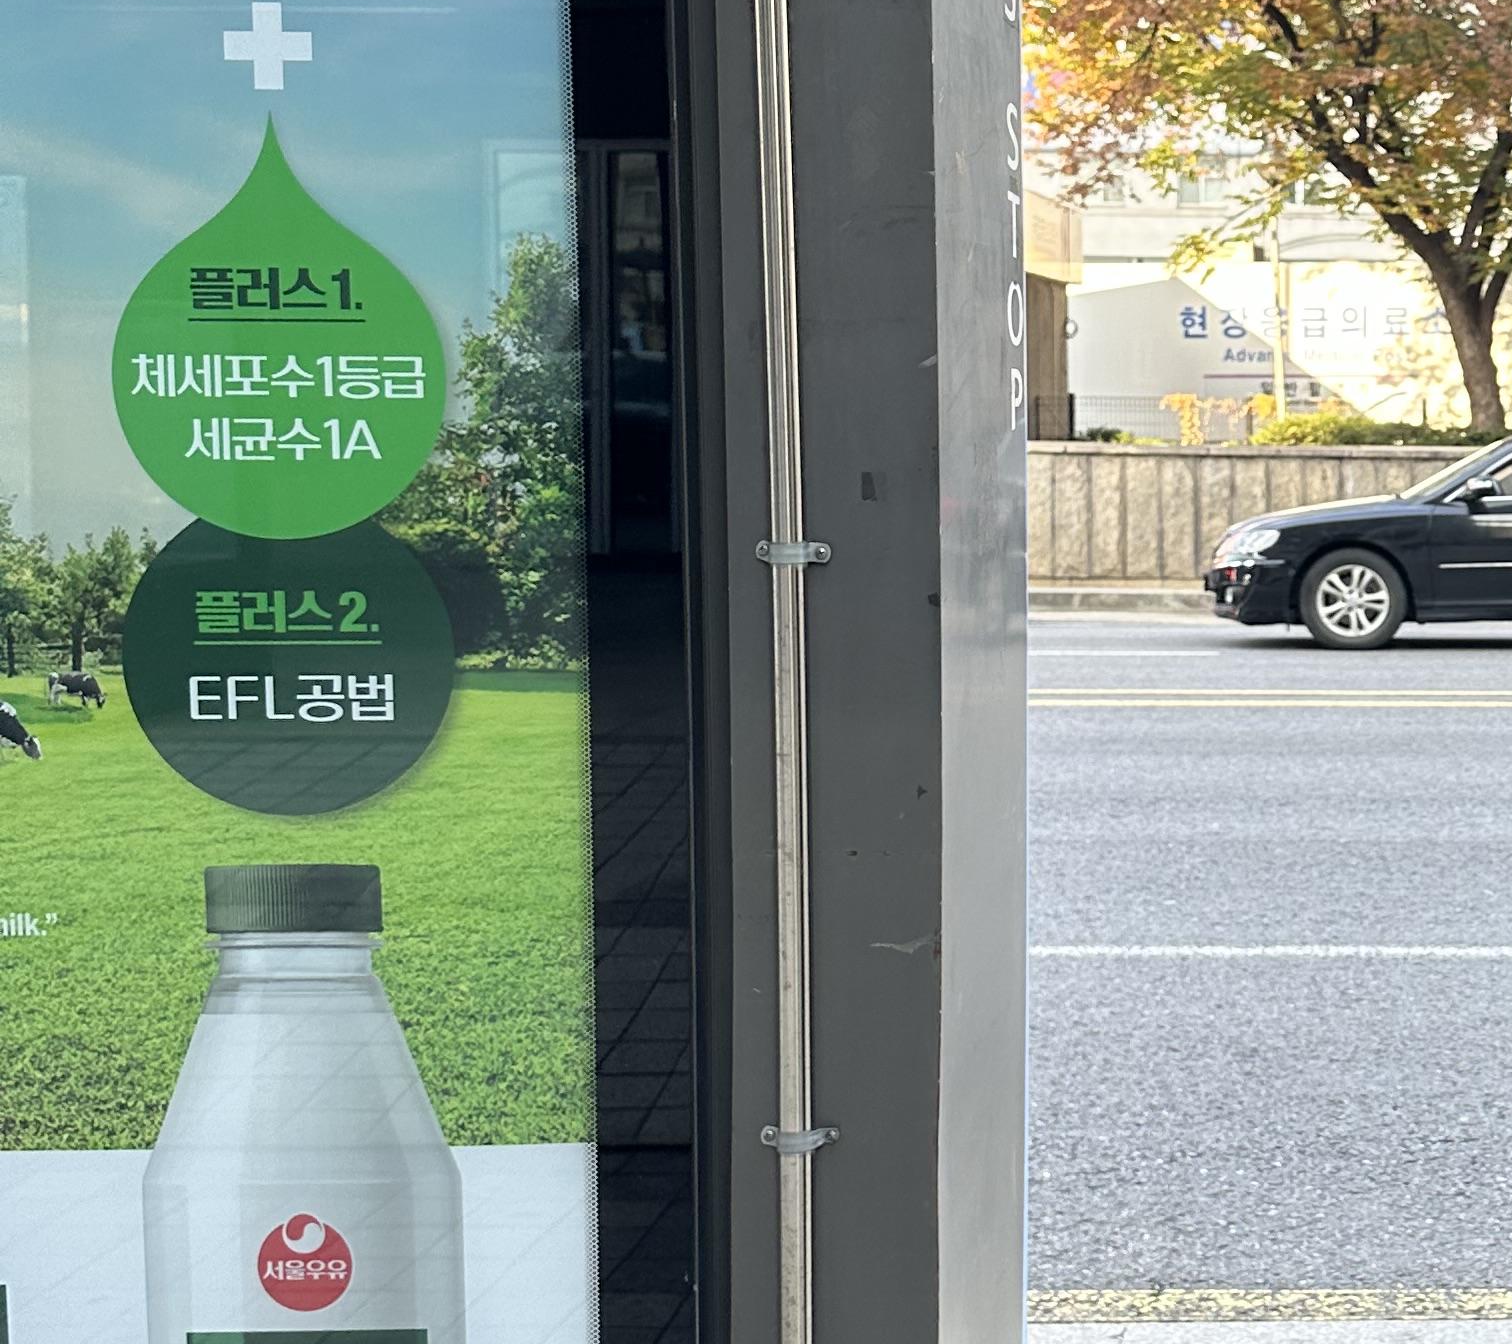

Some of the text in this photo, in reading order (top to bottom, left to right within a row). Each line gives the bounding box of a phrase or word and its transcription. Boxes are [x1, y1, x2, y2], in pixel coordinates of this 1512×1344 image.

[190, 267, 363, 310] 플러스1.
[1006, 102, 1025, 432] STOP
[131, 353, 427, 400] 체세포수1등급
[184, 418, 382, 461] 세균수1A
[195, 590, 380, 633] 플러스2.
[189, 673, 395, 723] EFL공법
[262, 1259, 348, 1281] 서울우유
